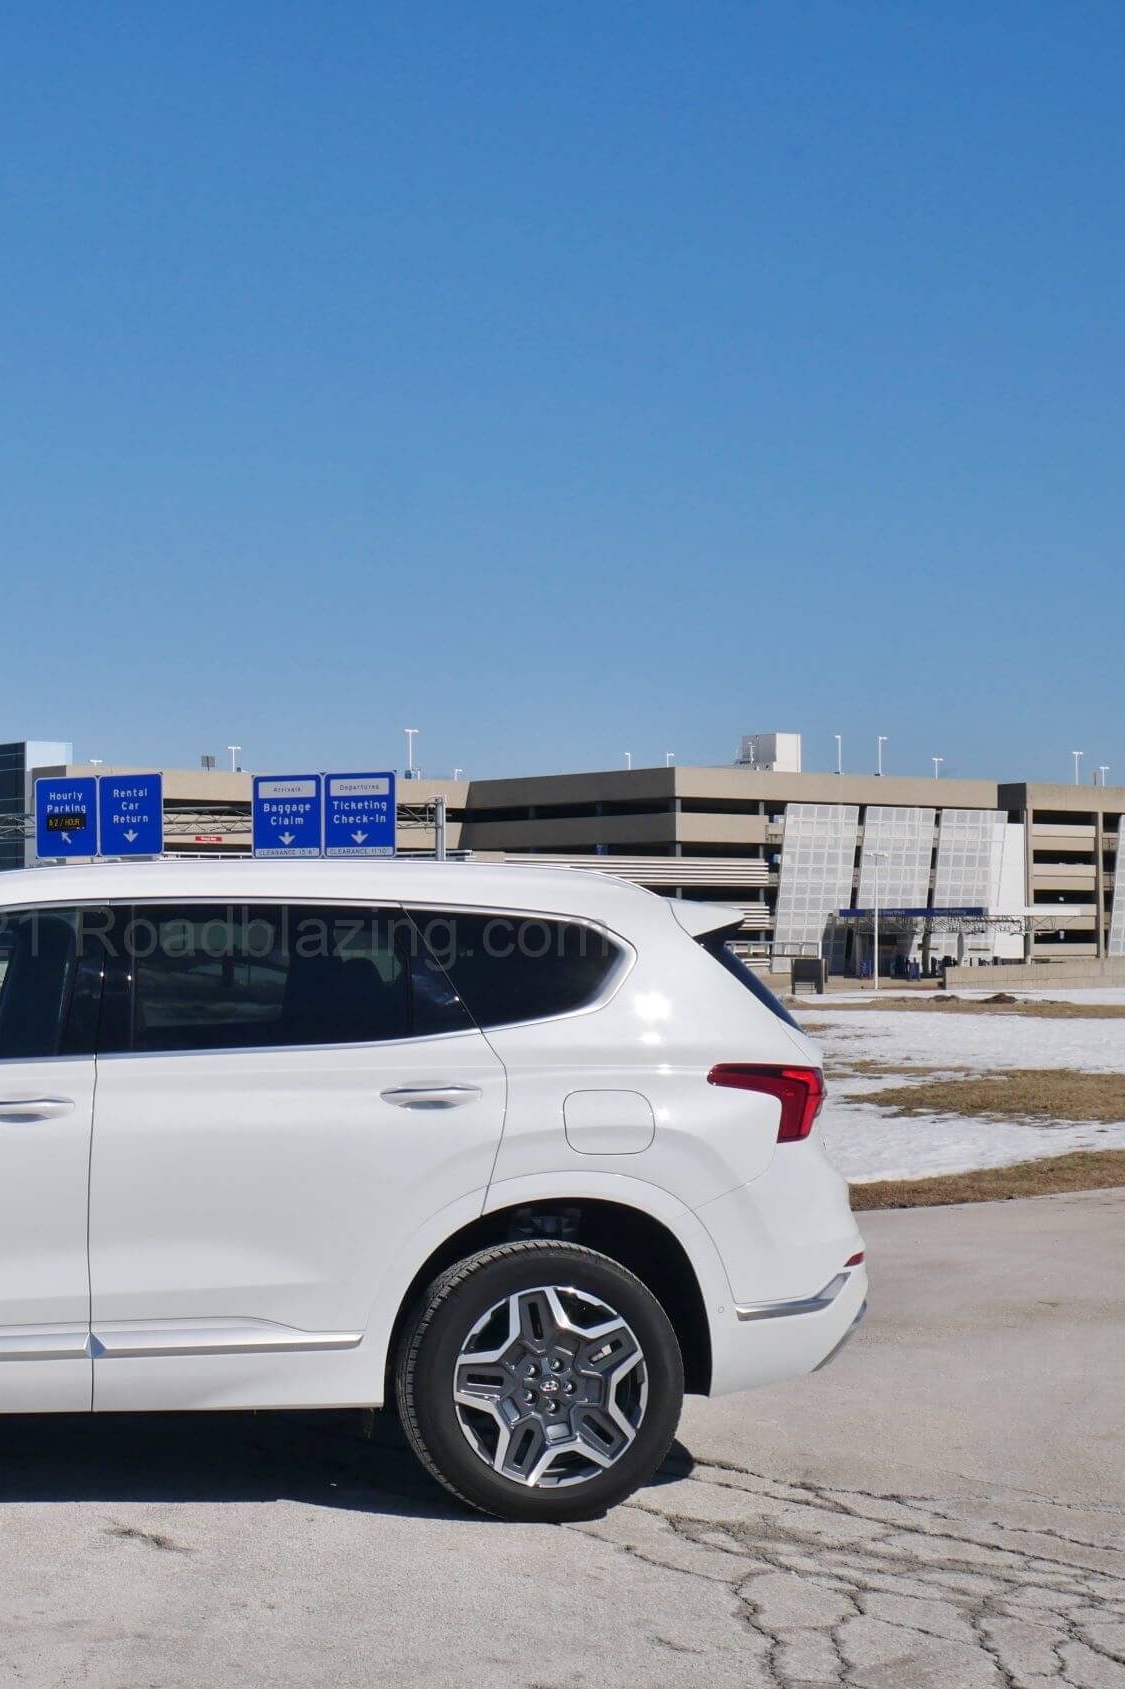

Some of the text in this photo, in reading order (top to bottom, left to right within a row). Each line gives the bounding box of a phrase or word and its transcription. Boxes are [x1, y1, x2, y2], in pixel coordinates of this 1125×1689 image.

[113, 788, 148, 798] Rental
[339, 784, 380, 792] Departures
[49, 791, 83, 801] Hourly
[46, 803, 87, 814] Parking
[121, 801, 140, 811] Car
[263, 803, 311, 815] Baggage
[332, 800, 387, 812] Ticketing
[113, 814, 149, 824] Return
[270, 815, 304, 826] Claim
[333, 814, 387, 824] Check-In
